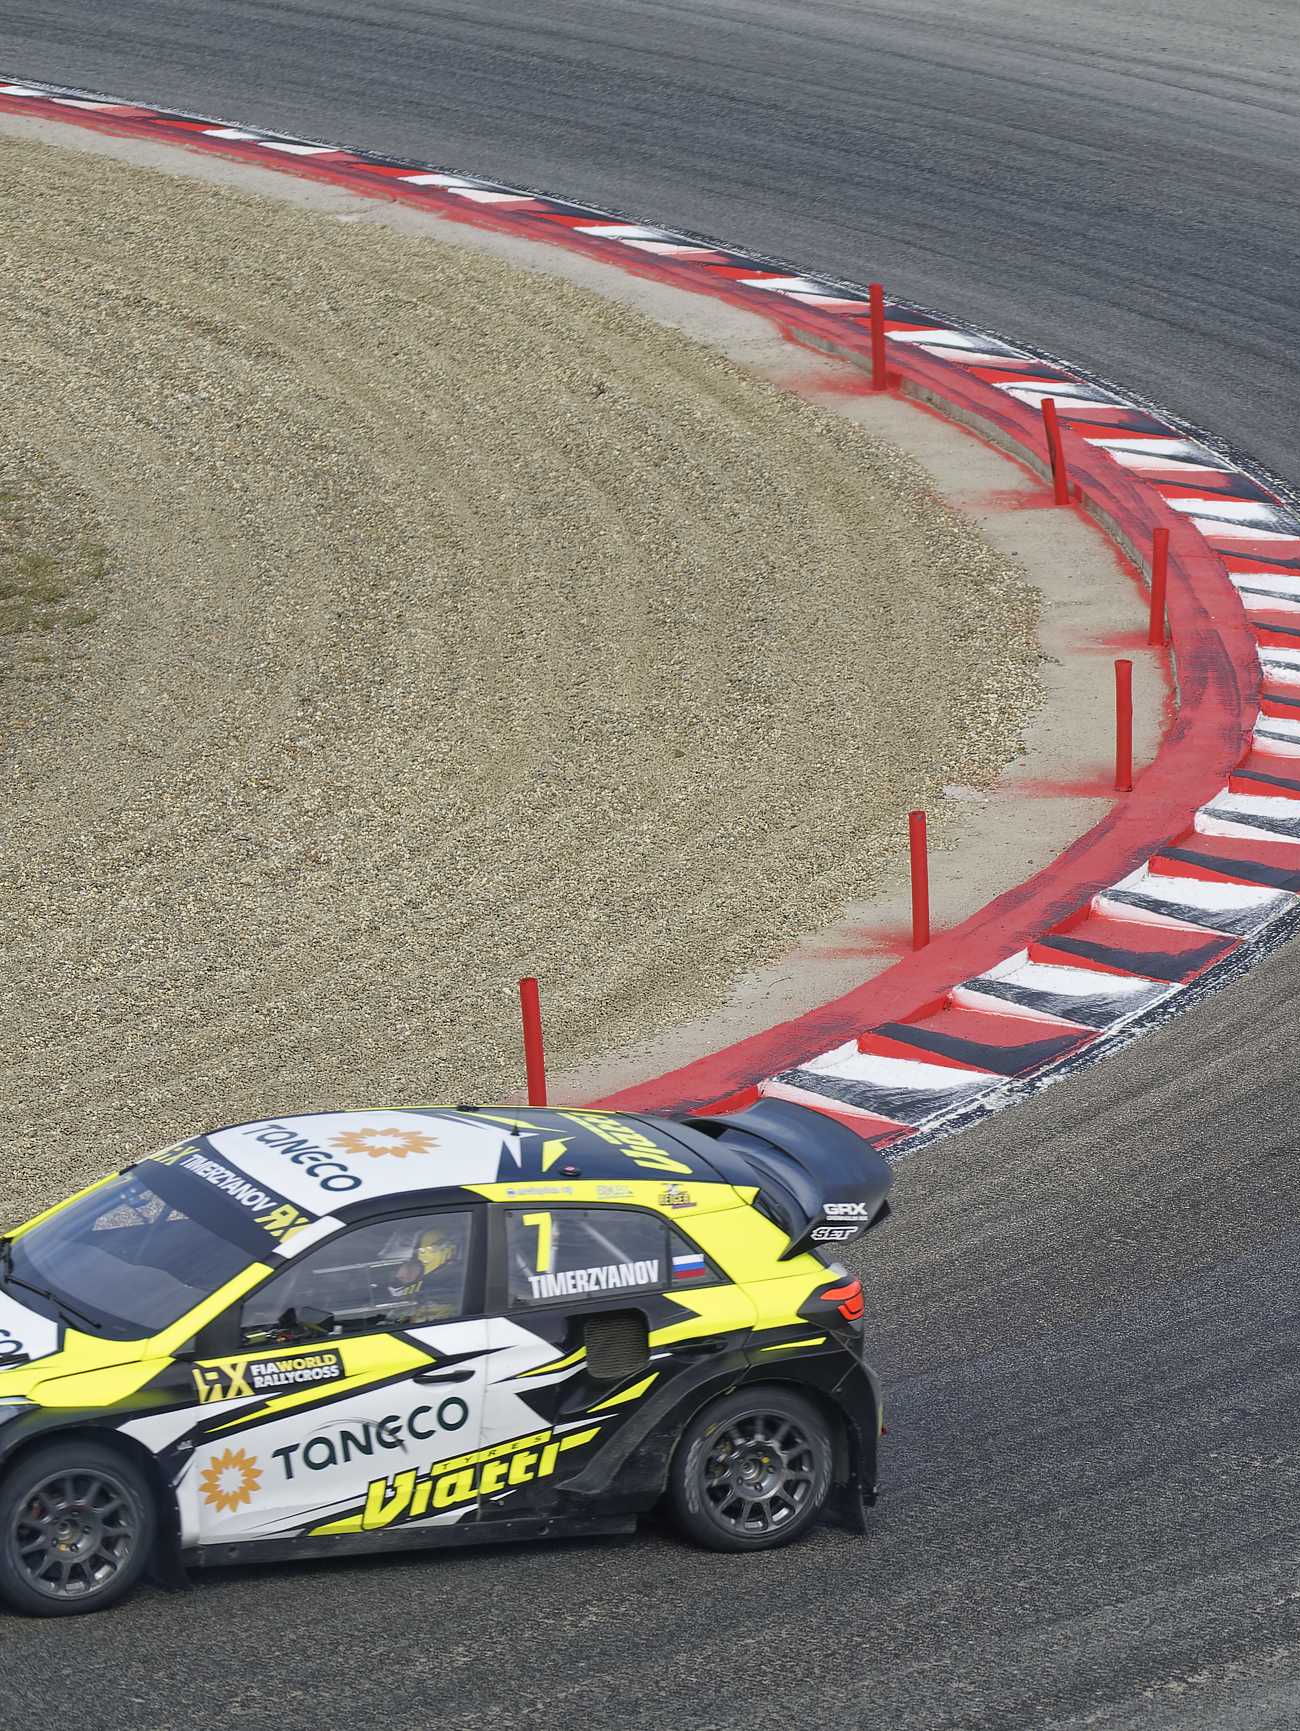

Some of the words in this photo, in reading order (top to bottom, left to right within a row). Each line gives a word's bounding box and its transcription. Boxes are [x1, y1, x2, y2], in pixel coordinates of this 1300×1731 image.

[179, 1154, 278, 1212] TIMERZYANOV
[823, 1202, 868, 1215] GRX
[522, 1212, 552, 1272] 7
[528, 1260, 660, 1299] TIMERZYANOV
[253, 1365, 340, 1388] RALLYCROSS
[442, 1436, 542, 1470] TYRES
